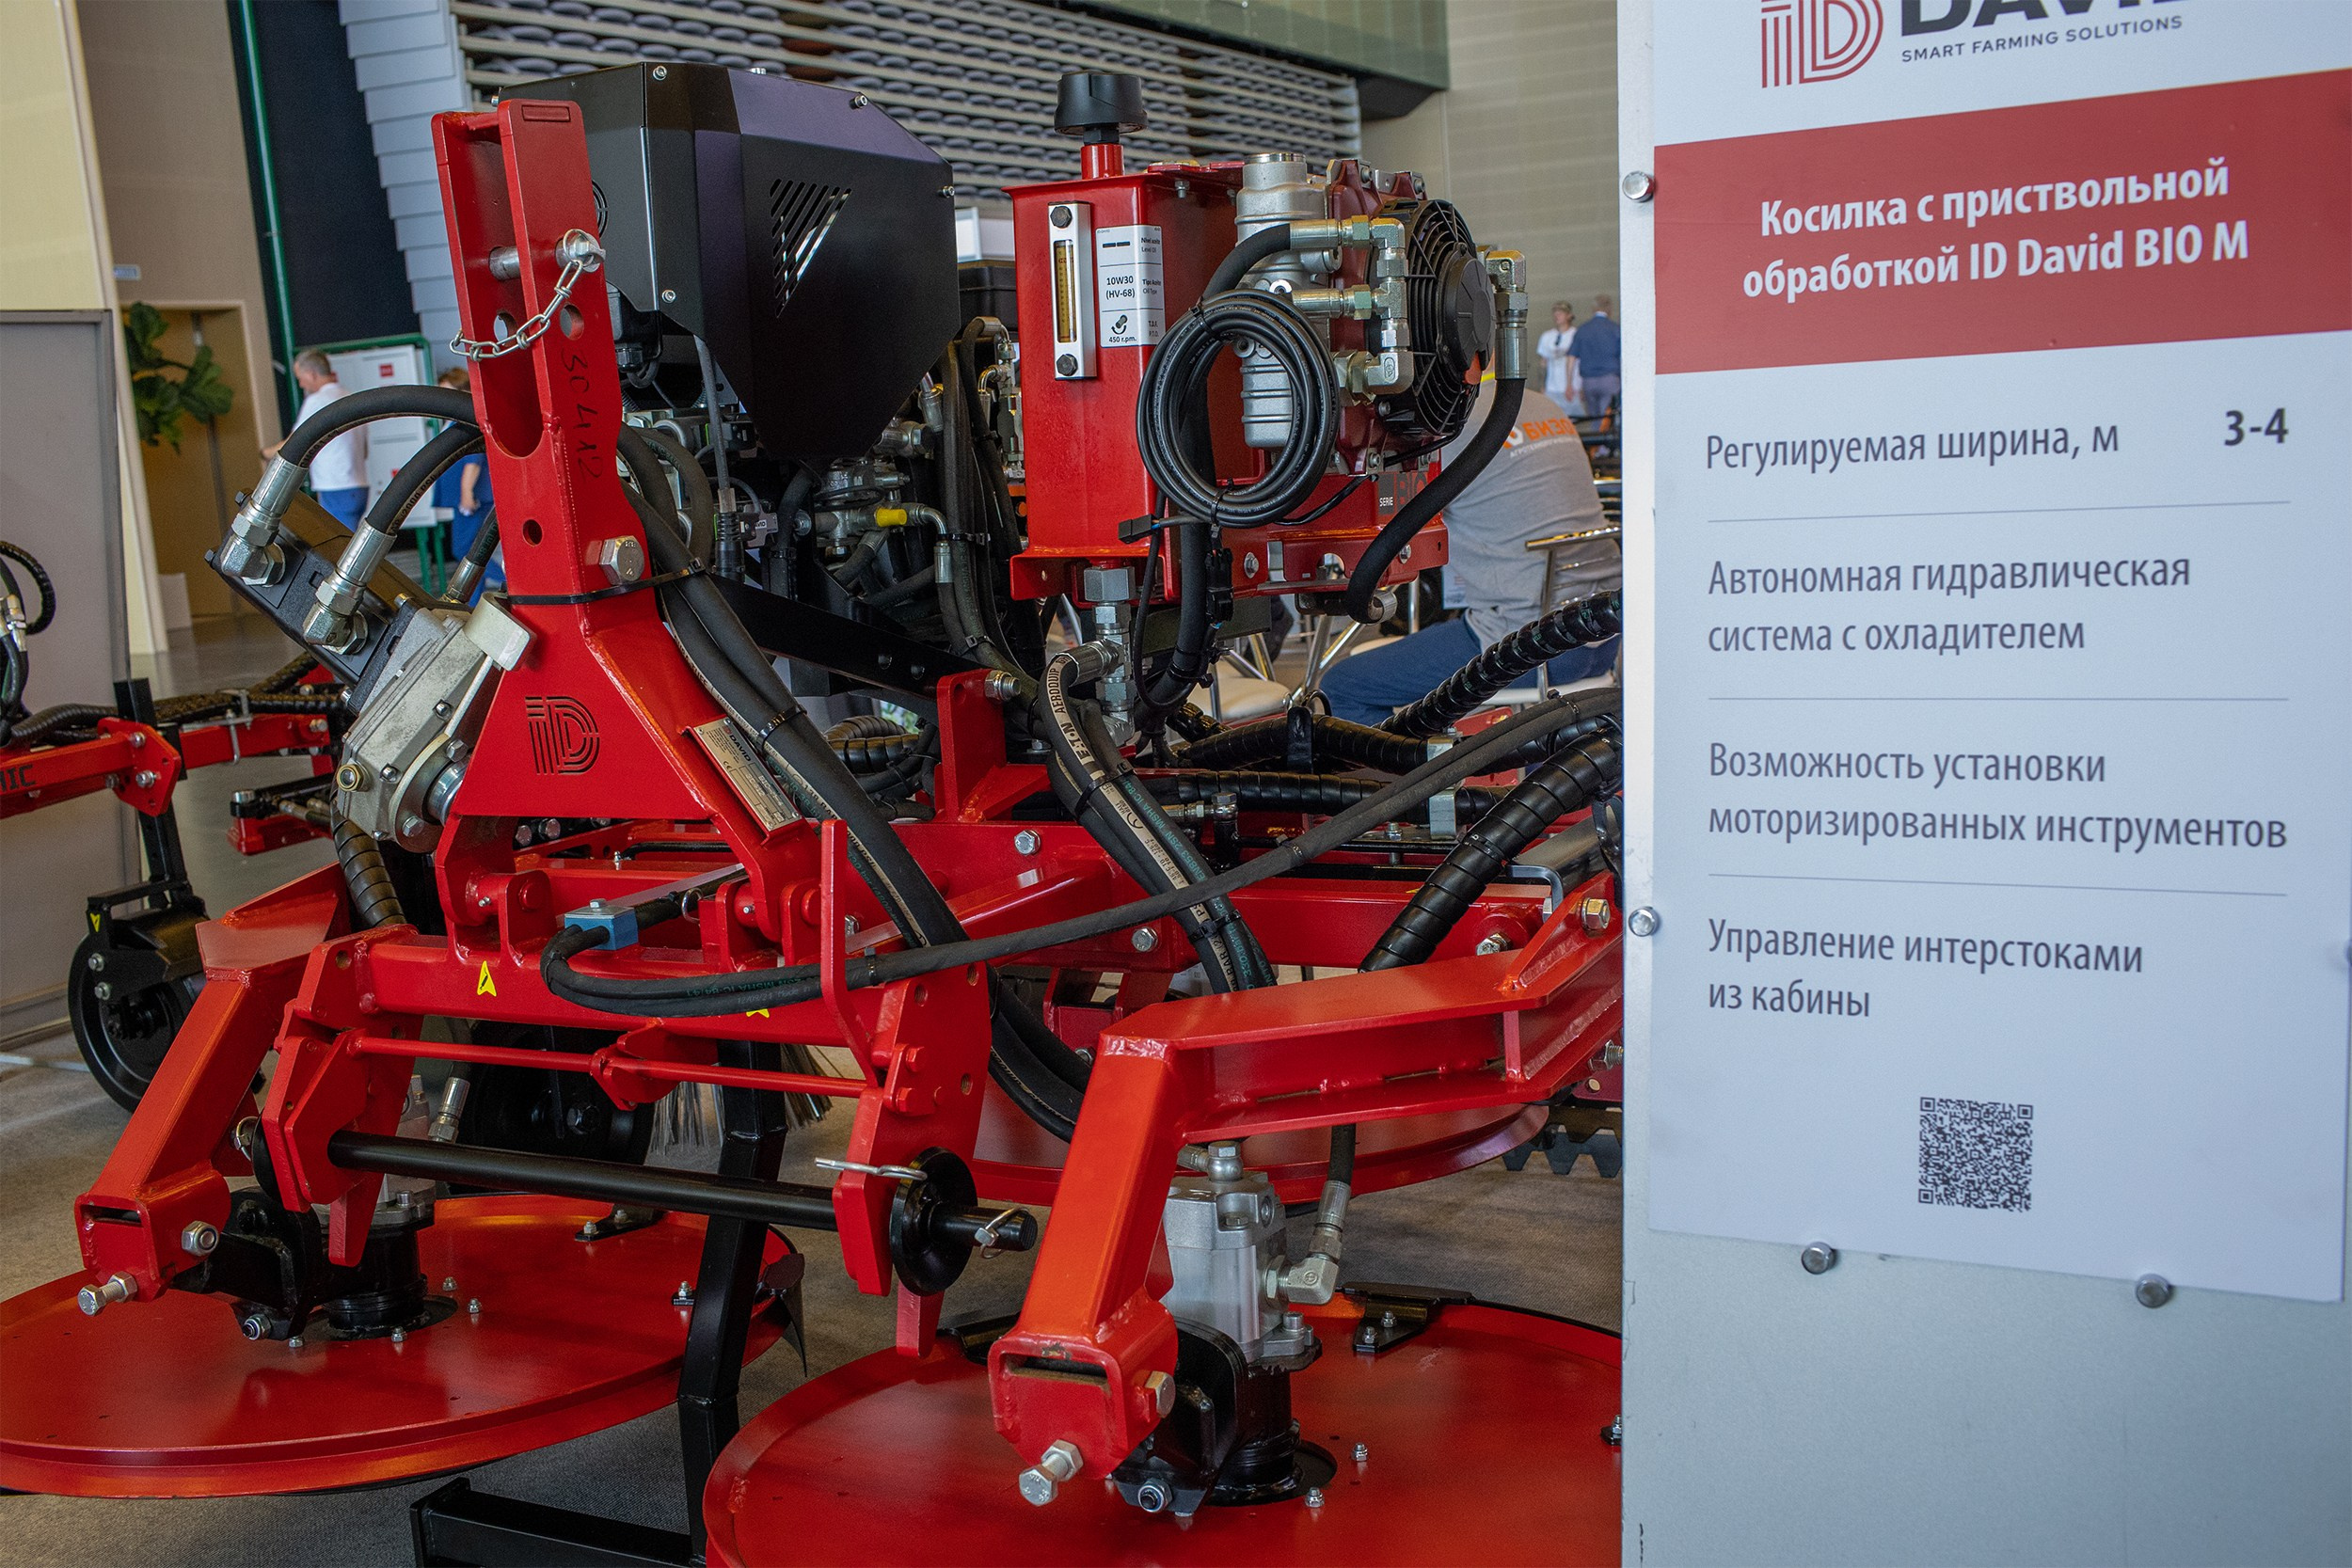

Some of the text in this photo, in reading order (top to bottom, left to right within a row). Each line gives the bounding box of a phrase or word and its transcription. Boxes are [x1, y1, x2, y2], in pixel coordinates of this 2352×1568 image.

[1901, 14, 2183, 63] SMART FARMING SOLUTIONS
[1761, 156, 2230, 238] Косилка с приствольной
[1106, 276, 1134, 285] 10W30
[1742, 245, 1959, 304] обработкой
[2018, 230, 2124, 277] David
[2136, 224, 2203, 268] BIO
[1105, 288, 1136, 300] (HV-68)
[1707, 406, 2290, 478] Регулируемая ширина, м 3-4
[1379, 497, 1393, 507] SERIE
[1708, 557, 2190, 600] Автономная гидравлическая
[1708, 621, 2085, 657] система с охладителем
[1047, 668, 1067, 714] AEROQUIP
[729, 735, 752, 762] DAVID
[1709, 741, 2106, 790] Возможность установки
[1141, 800, 1166, 830] MSHA
[1708, 806, 2288, 855] моторизированных инструментов
[1708, 917, 2143, 975] Управление интерстоками
[1708, 977, 1870, 1019] из кабины
